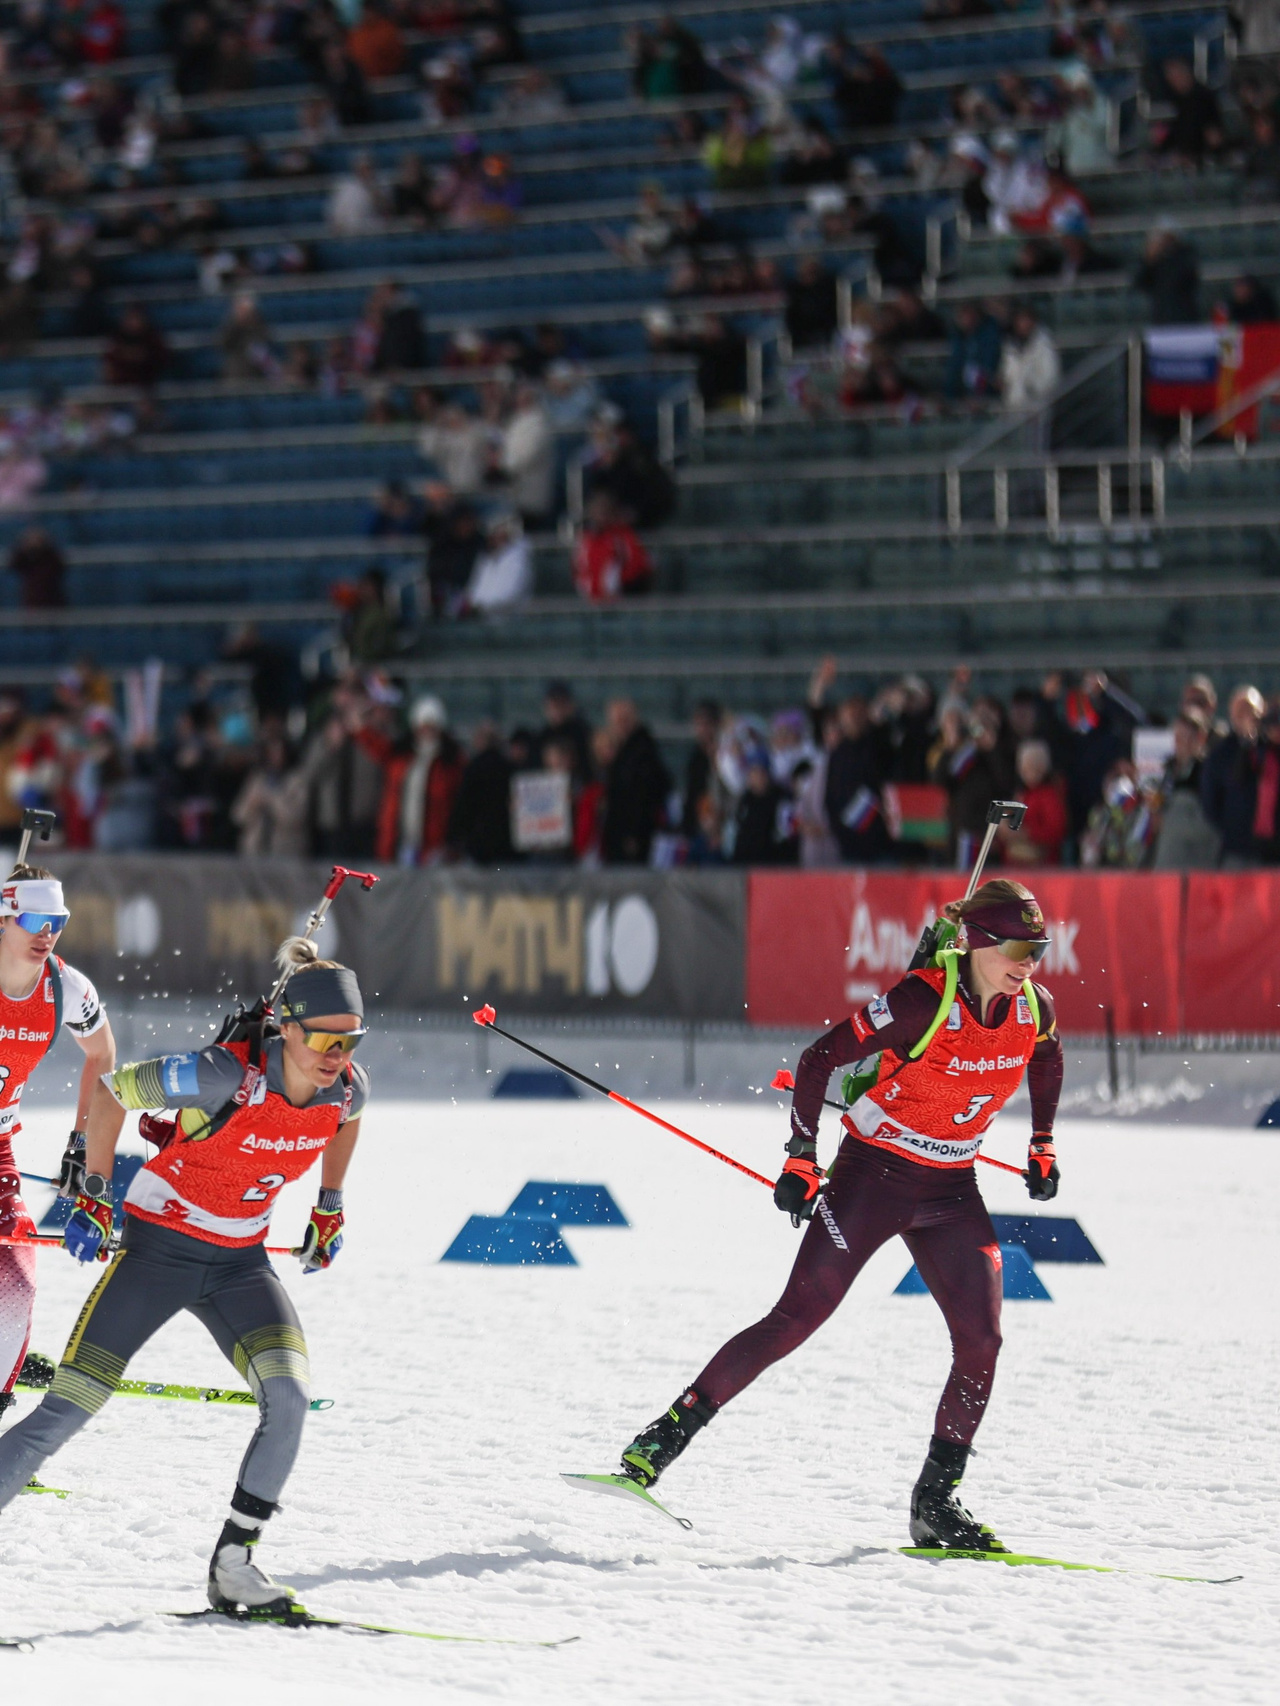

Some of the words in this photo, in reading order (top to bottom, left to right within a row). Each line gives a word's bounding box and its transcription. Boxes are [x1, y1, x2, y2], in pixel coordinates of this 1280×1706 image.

[18, 1027, 50, 1043] Банк
[946, 1056, 996, 1075] Альфа
[997, 1055, 1025, 1070] Банк
[884, 1082, 902, 1102] 3
[952, 1094, 994, 1126] 3
[240, 1133, 294, 1152] Альфа
[296, 1135, 329, 1151] Банк
[241, 1173, 286, 1202] 2
[819, 1199, 850, 1253] roteam
[945, 1550, 987, 1561] FISCHER
